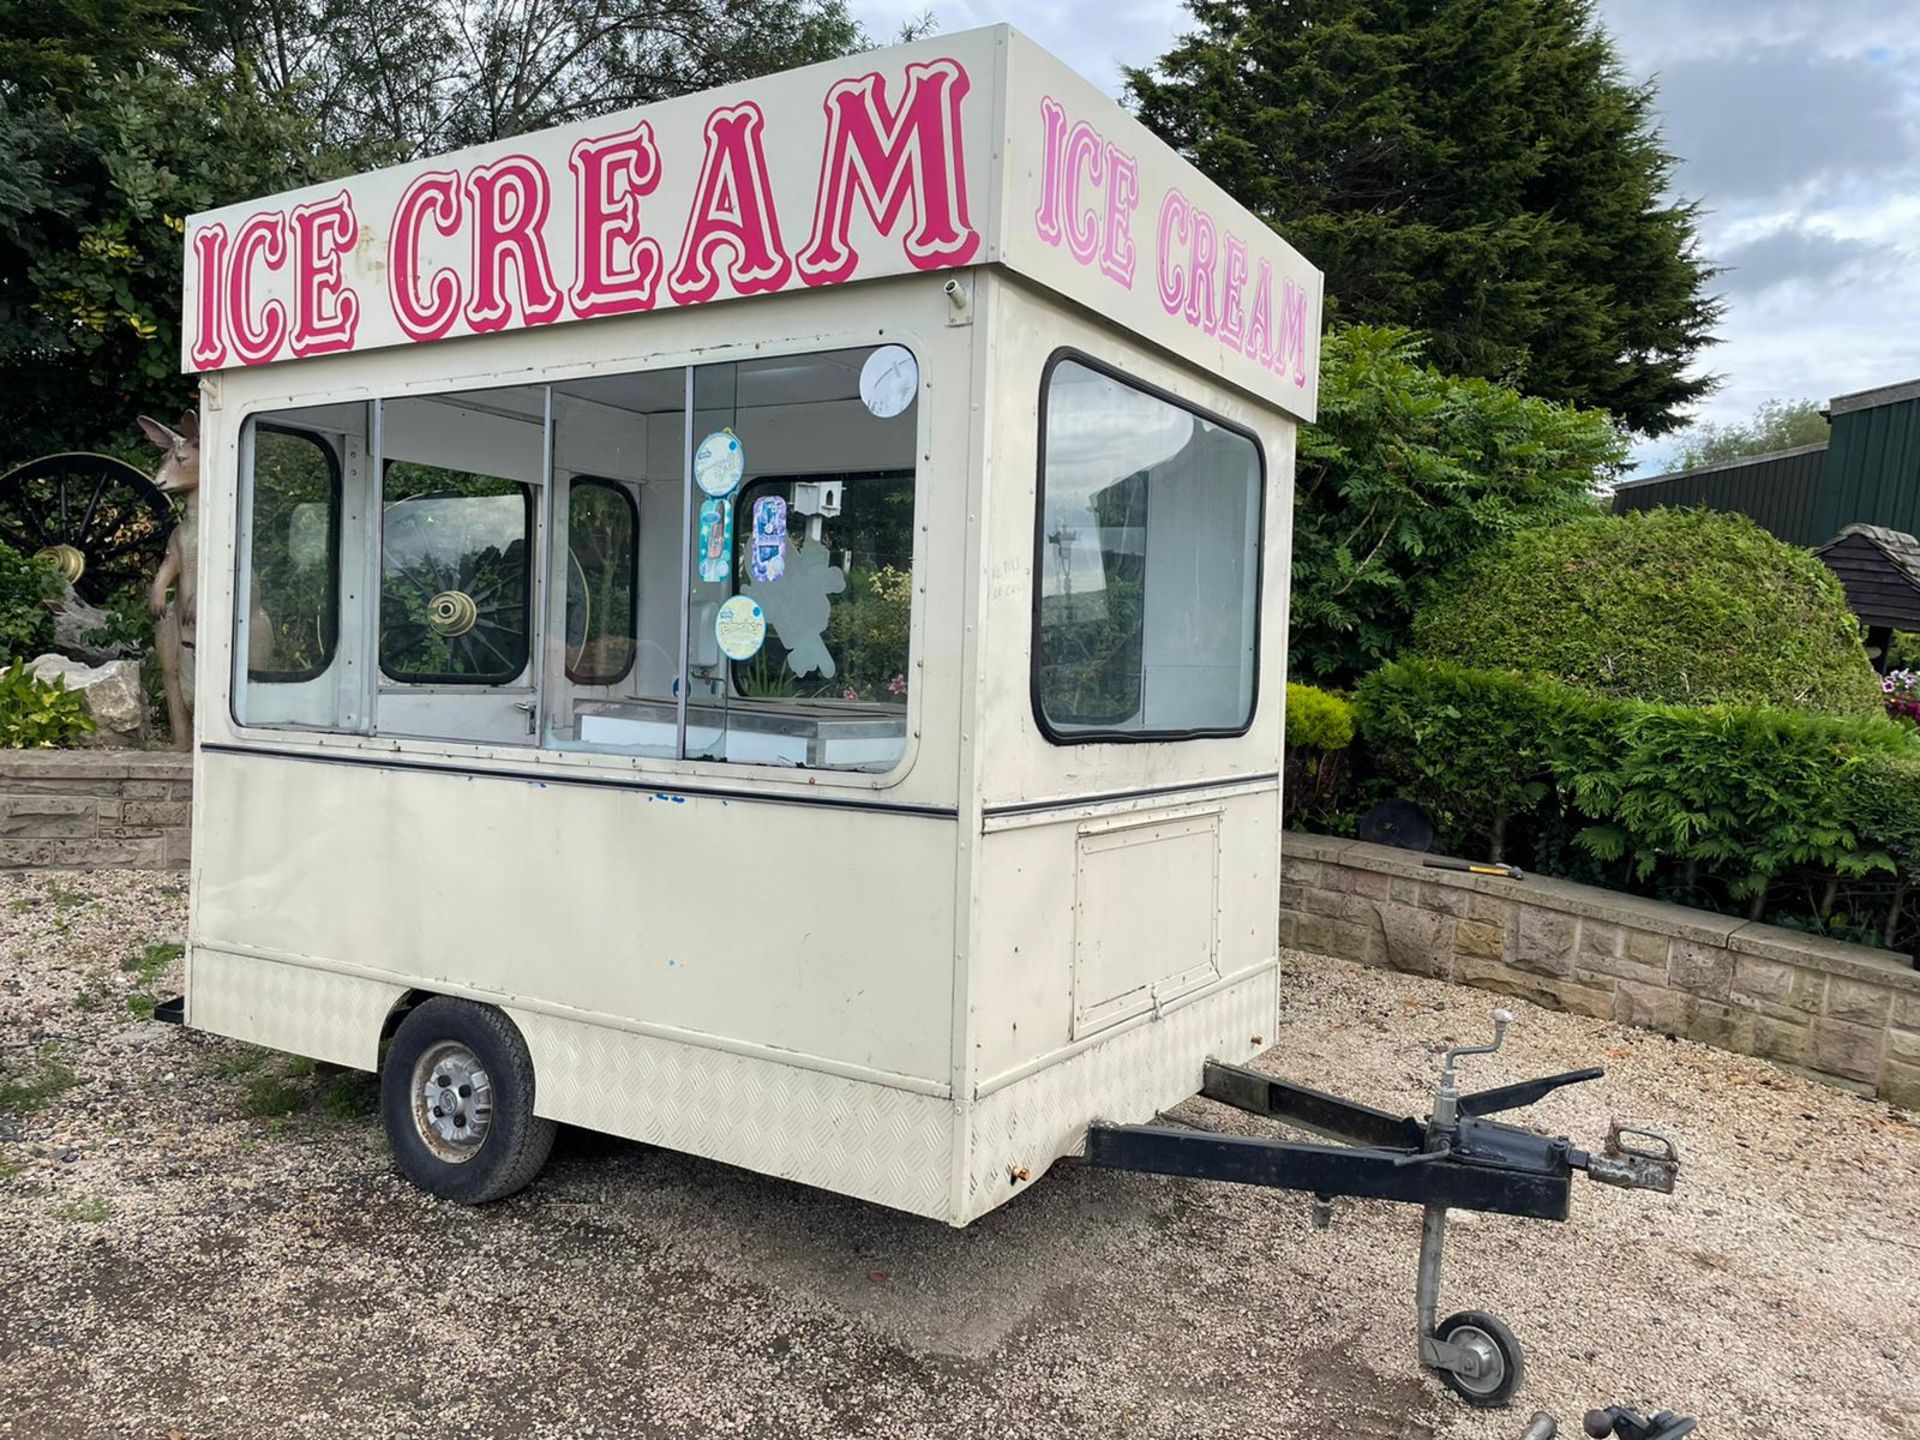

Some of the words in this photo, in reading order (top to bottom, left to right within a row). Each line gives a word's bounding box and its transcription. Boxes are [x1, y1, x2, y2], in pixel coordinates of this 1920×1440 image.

[192, 190, 360, 372] ICE
[390, 58, 980, 342] CREAM
[1035, 96, 1140, 291] ICE
[1157, 187, 1308, 389] CREAM
